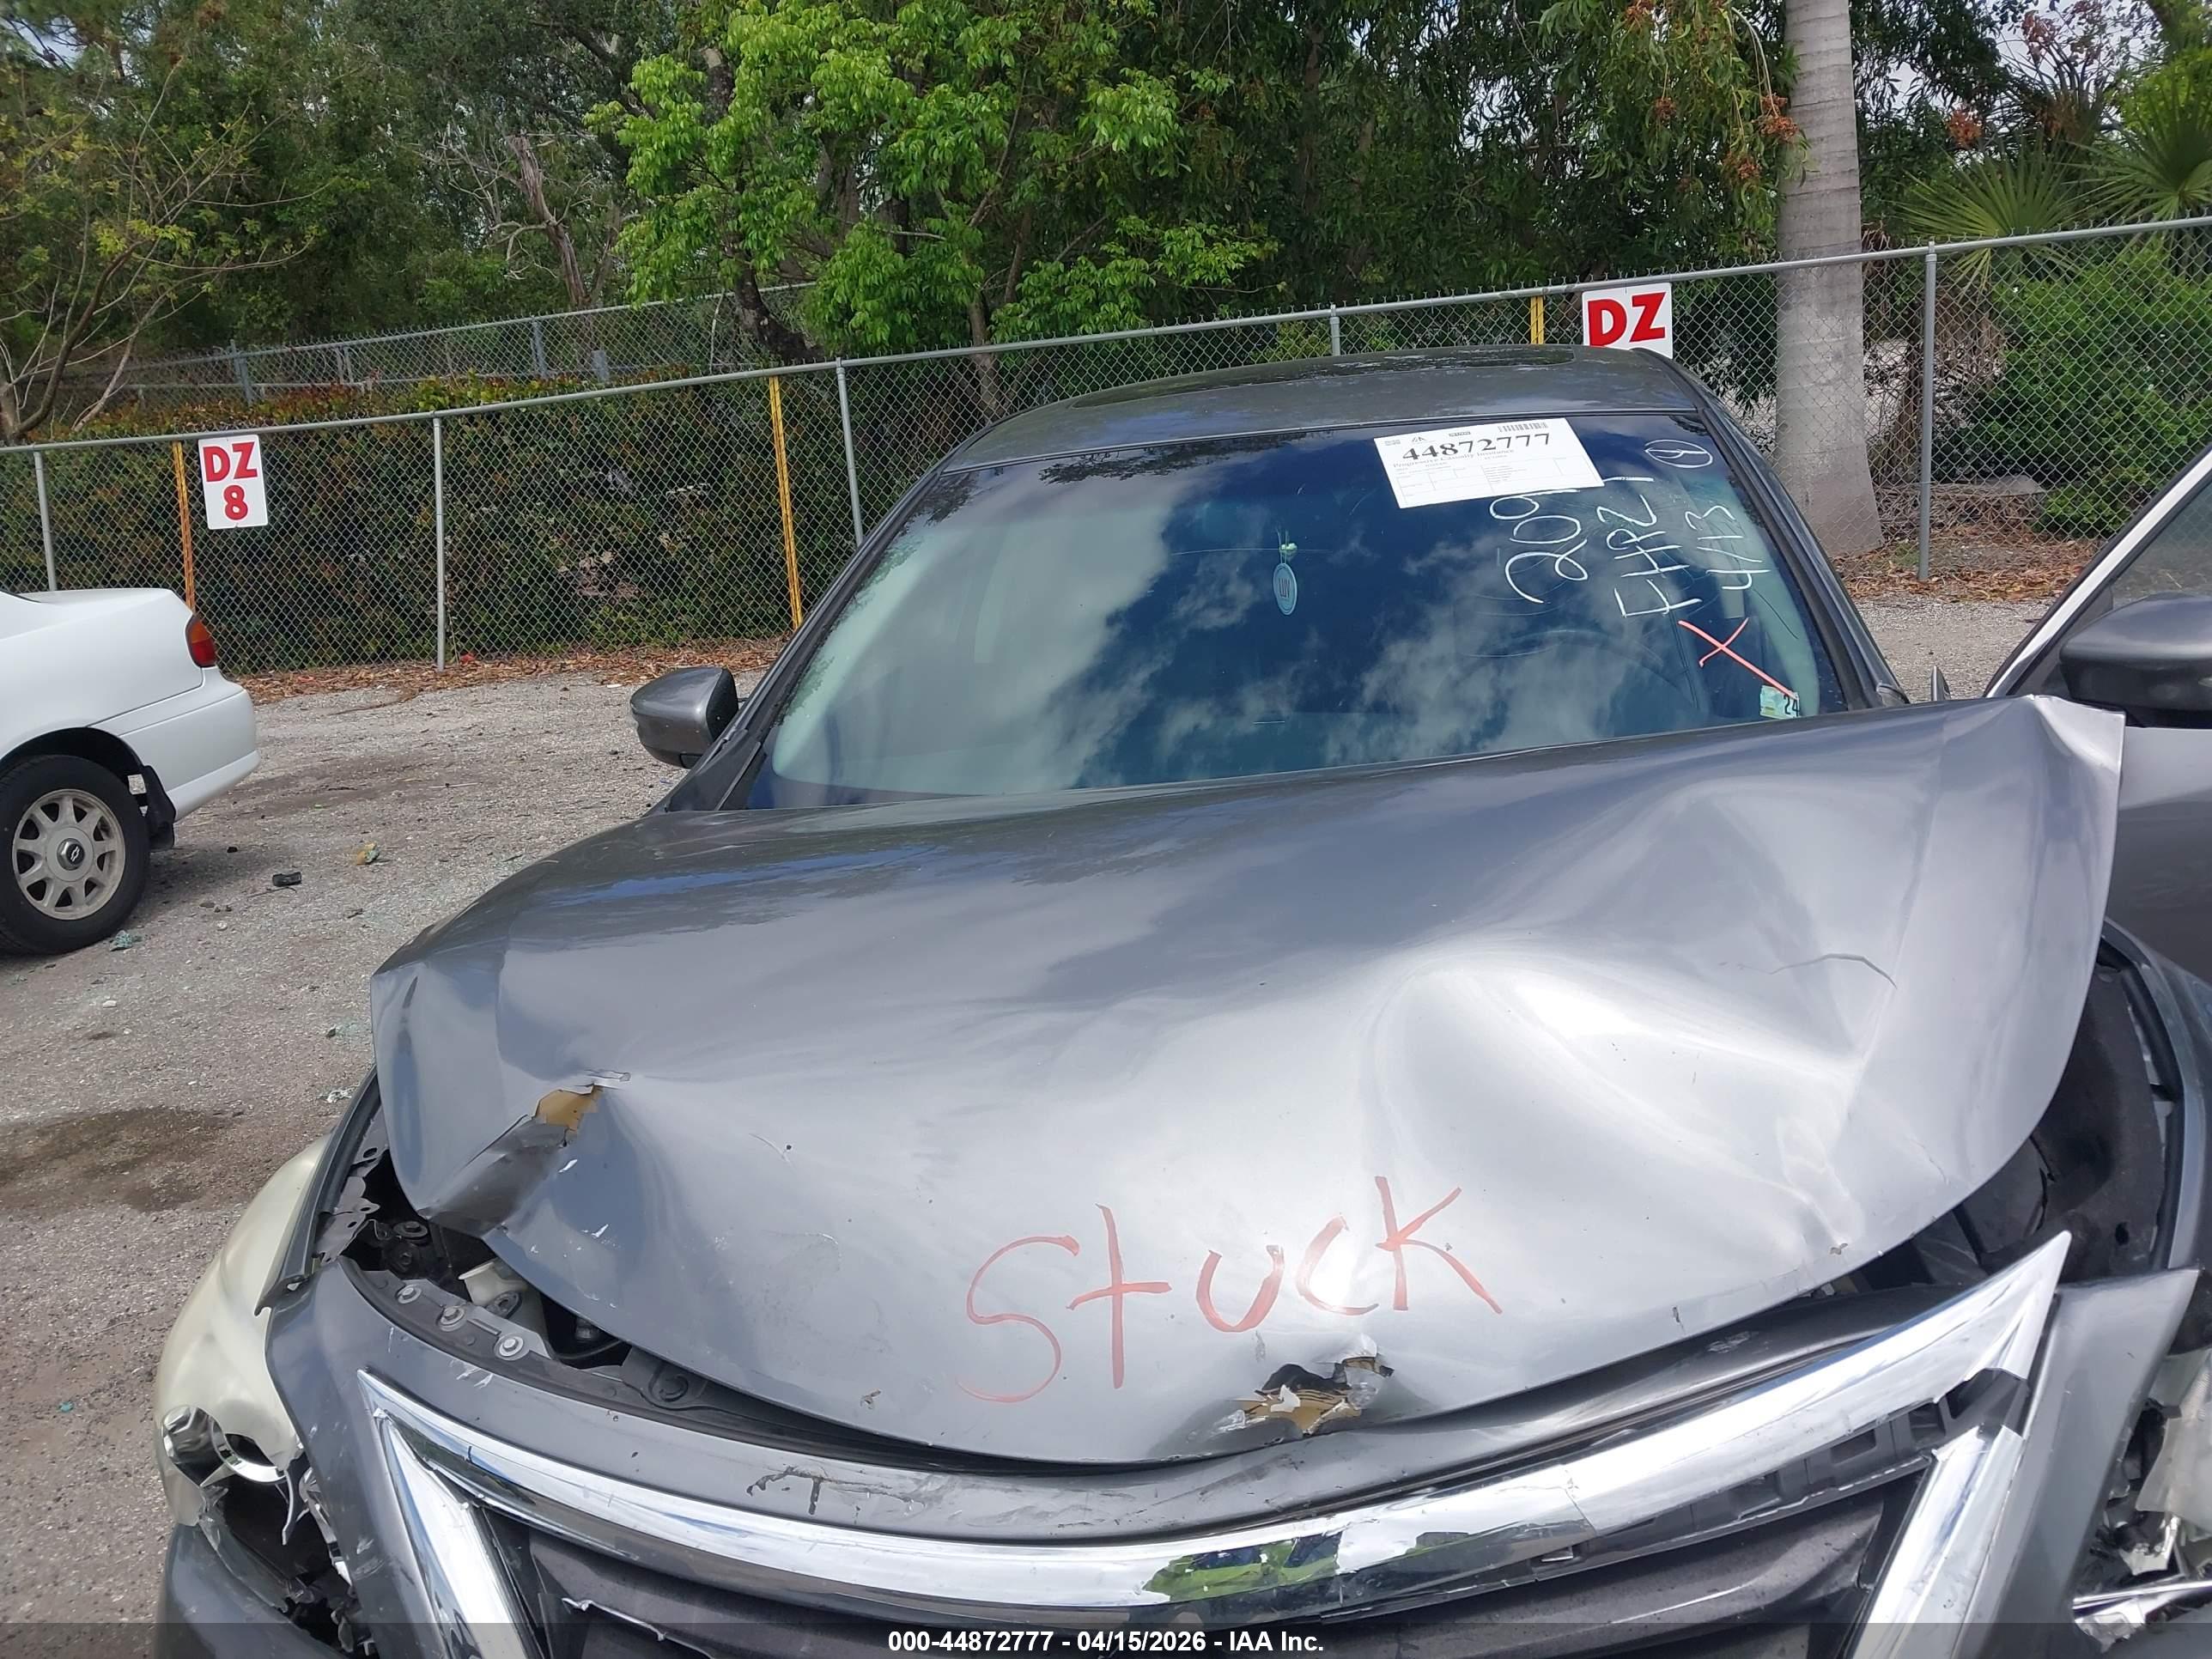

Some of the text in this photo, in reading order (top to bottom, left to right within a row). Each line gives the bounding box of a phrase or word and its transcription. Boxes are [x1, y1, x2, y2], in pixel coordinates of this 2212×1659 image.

[1587, 291, 1667, 347] DZ
[202, 441, 258, 483] DZ
[1402, 432, 1550, 460] 44872777
[222, 483, 249, 521] 8
[1489, 489, 1588, 604] 209
